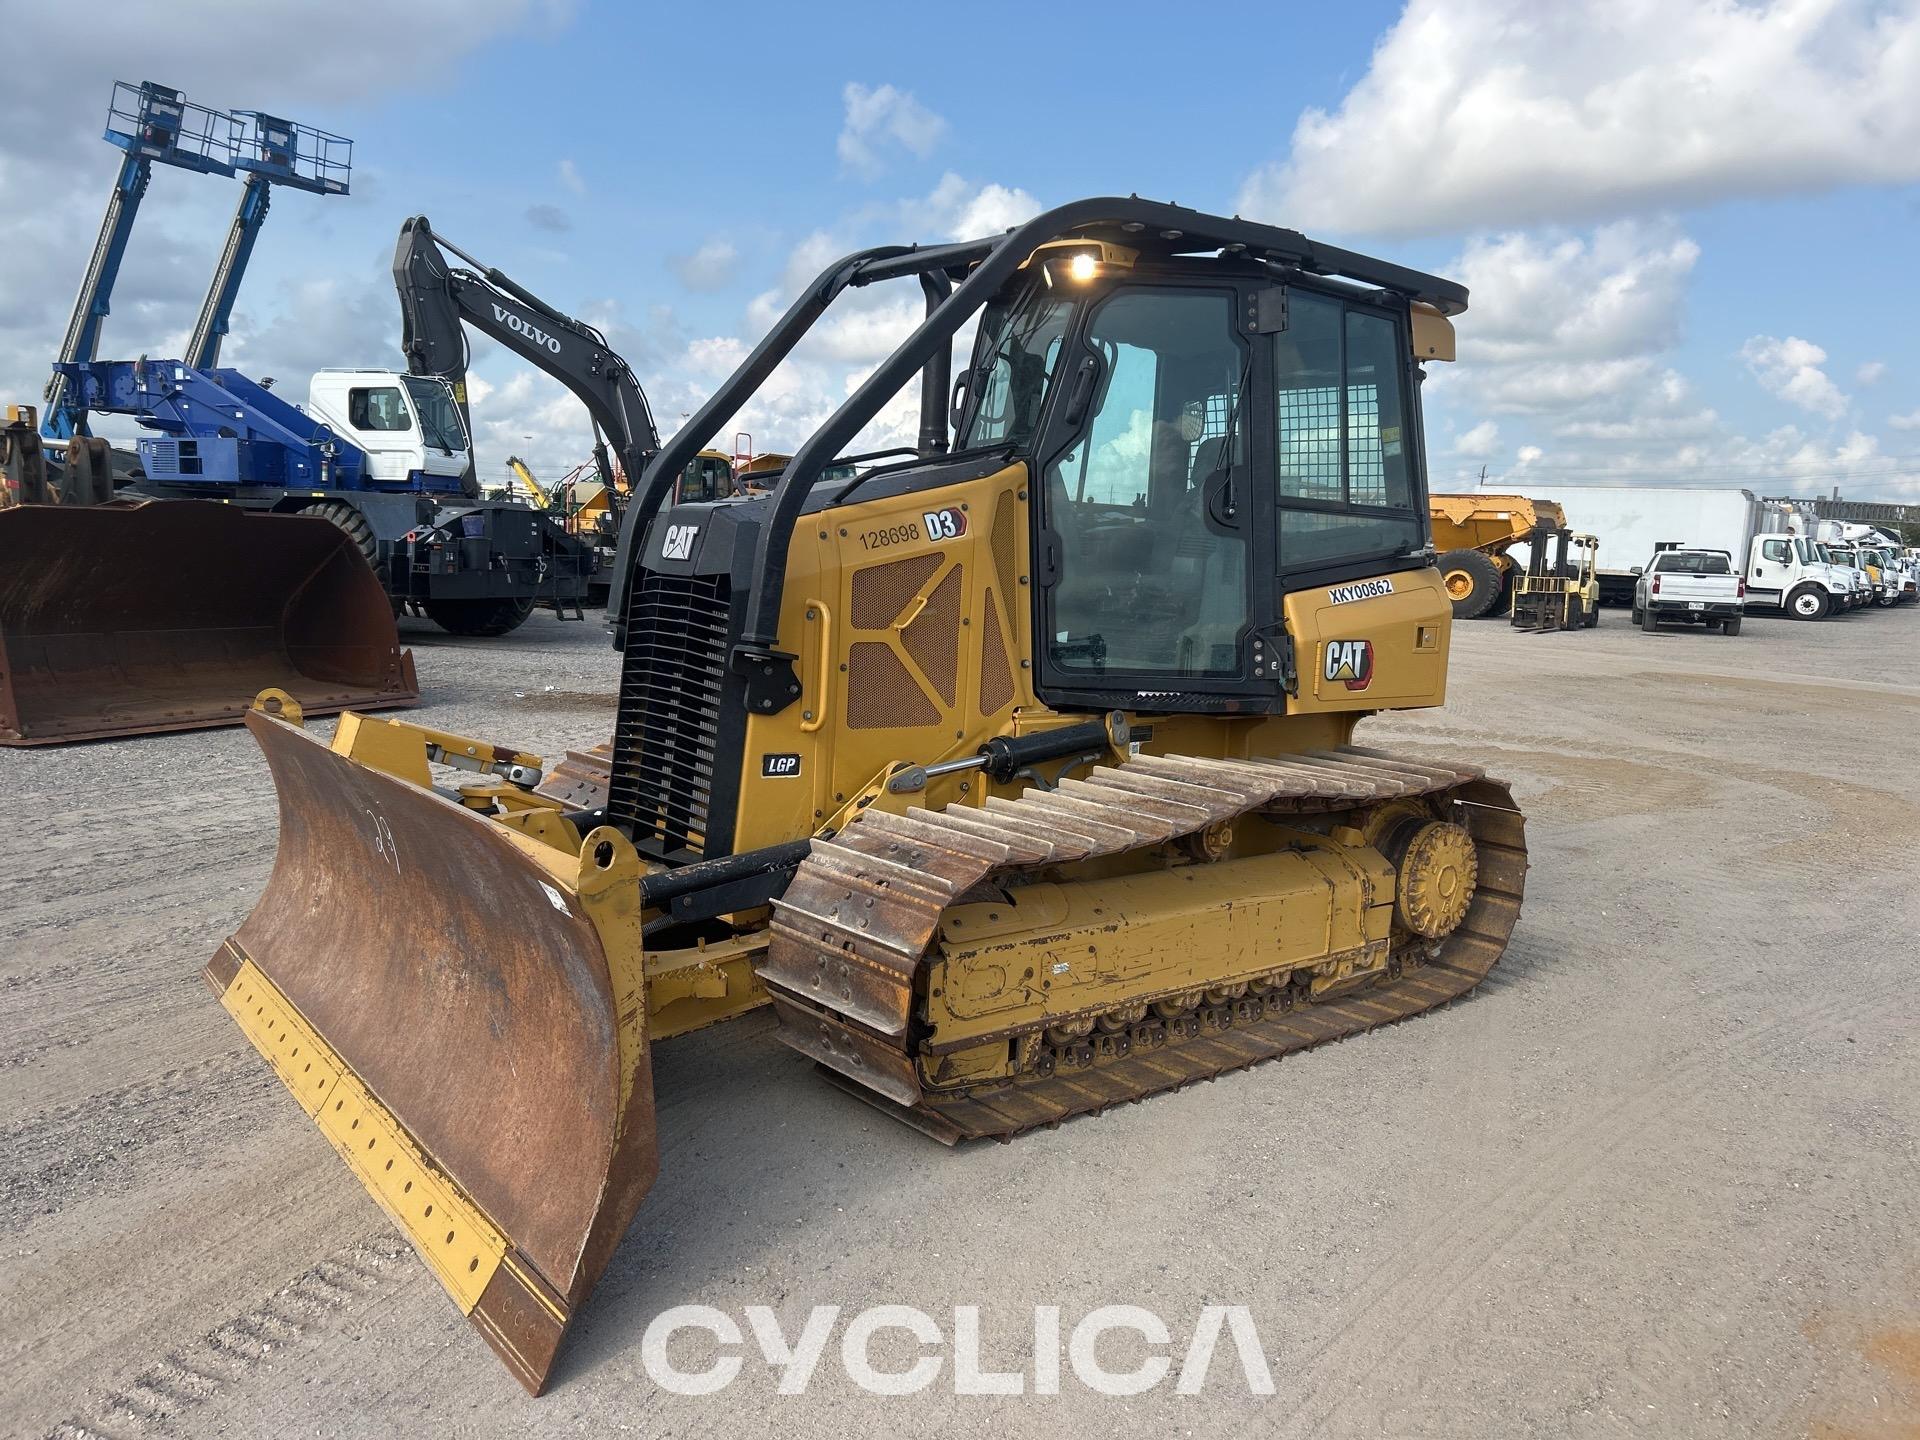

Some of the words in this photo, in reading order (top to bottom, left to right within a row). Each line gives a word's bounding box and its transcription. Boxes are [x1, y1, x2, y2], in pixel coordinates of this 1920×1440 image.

[491, 302, 561, 354] VOLVO
[859, 523, 920, 550] 128698
[923, 509, 957, 542] D3
[661, 525, 699, 560] CAT
[1329, 580, 1392, 604] XKY00862
[1325, 640, 1366, 680] CAT
[768, 757, 796, 773] LGP
